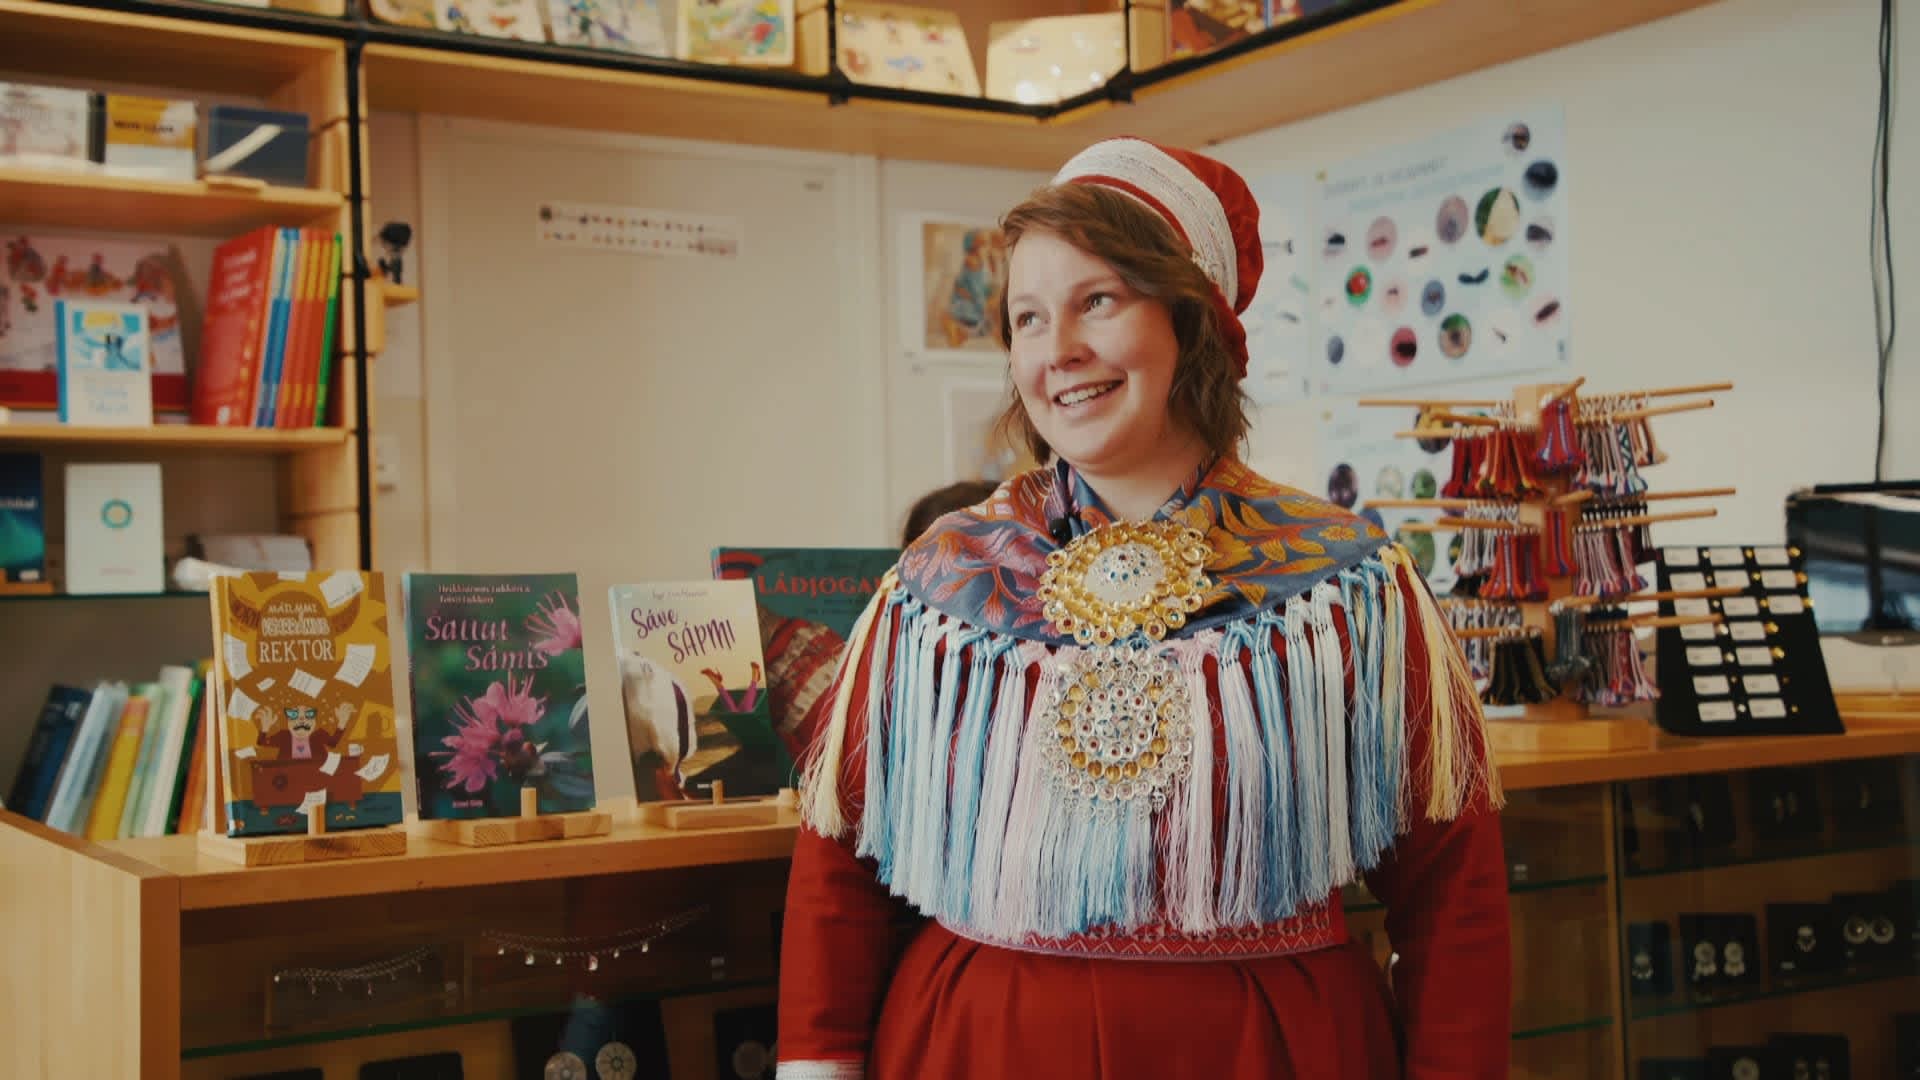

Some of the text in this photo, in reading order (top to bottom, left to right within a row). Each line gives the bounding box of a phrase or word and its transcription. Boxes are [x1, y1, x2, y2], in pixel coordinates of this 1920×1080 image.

[756, 571, 883, 599] LÁDJOGA
[630, 607, 677, 639] Sáve
[259, 639, 335, 663] REKTOR
[464, 640, 548, 671] Sámis
[667, 618, 736, 664] SÁPMI
